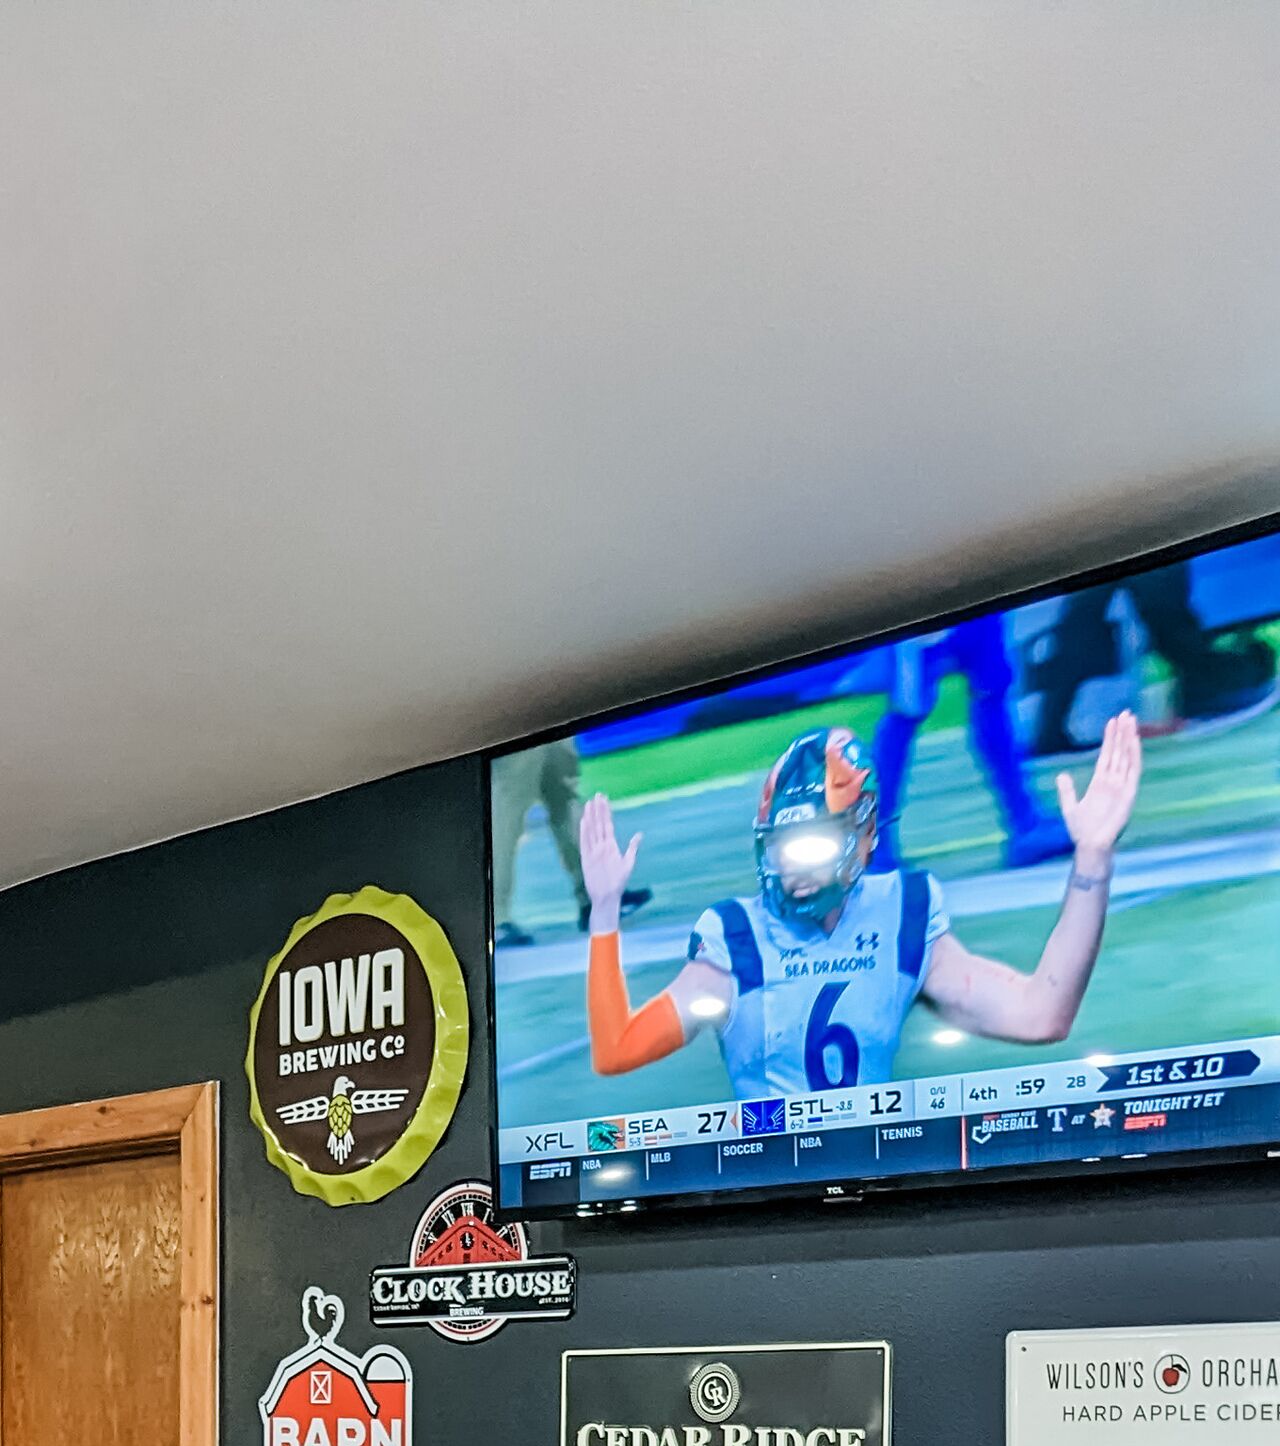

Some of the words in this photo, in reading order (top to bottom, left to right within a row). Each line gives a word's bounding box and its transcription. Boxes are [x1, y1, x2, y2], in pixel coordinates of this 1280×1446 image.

[785, 963, 809, 977] SEA
[813, 955, 876, 975] DRAGONS
[278, 947, 405, 1047] IOWA
[803, 981, 860, 1092] 6
[278, 1038, 377, 1077] BREWING
[1126, 1064, 1164, 1086] 1st
[1168, 1060, 1187, 1081] &
[1191, 1056, 1224, 1078] 10
[969, 1086, 998, 1101] 4th
[1015, 1078, 1045, 1097] :59
[1066, 1076, 1086, 1089] 28
[789, 1097, 834, 1118] STL
[869, 1091, 903, 1115] 12
[930, 1097, 945, 1110] 46
[1124, 1095, 1191, 1115] TONIGHT
[1192, 1094, 1202, 1109] 7
[1203, 1093, 1224, 1108] ET
[628, 1117, 669, 1134] SEA
[697, 1111, 727, 1134] 27
[790, 1118, 804, 1130] 6-2
[981, 1115, 1039, 1133] BASEBALL
[1071, 1115, 1086, 1125] AT
[1124, 1113, 1167, 1131] ESPN
[524, 1132, 575, 1154] XFL
[723, 1142, 764, 1156] SOCCER
[800, 1136, 822, 1149] NBA
[582, 1159, 602, 1171] NBA
[650, 1151, 671, 1163] MLB
[529, 1161, 572, 1180] ESPN
[827, 1186, 844, 1195] TCL
[372, 1276, 466, 1304] CLOCK
[466, 1270, 571, 1300] HOUSE
[449, 1306, 485, 1317] BREWING
[1046, 1361, 1144, 1390] WILSON'S
[1062, 1405, 1122, 1422] HARD
[1133, 1404, 1207, 1422] APPLE
